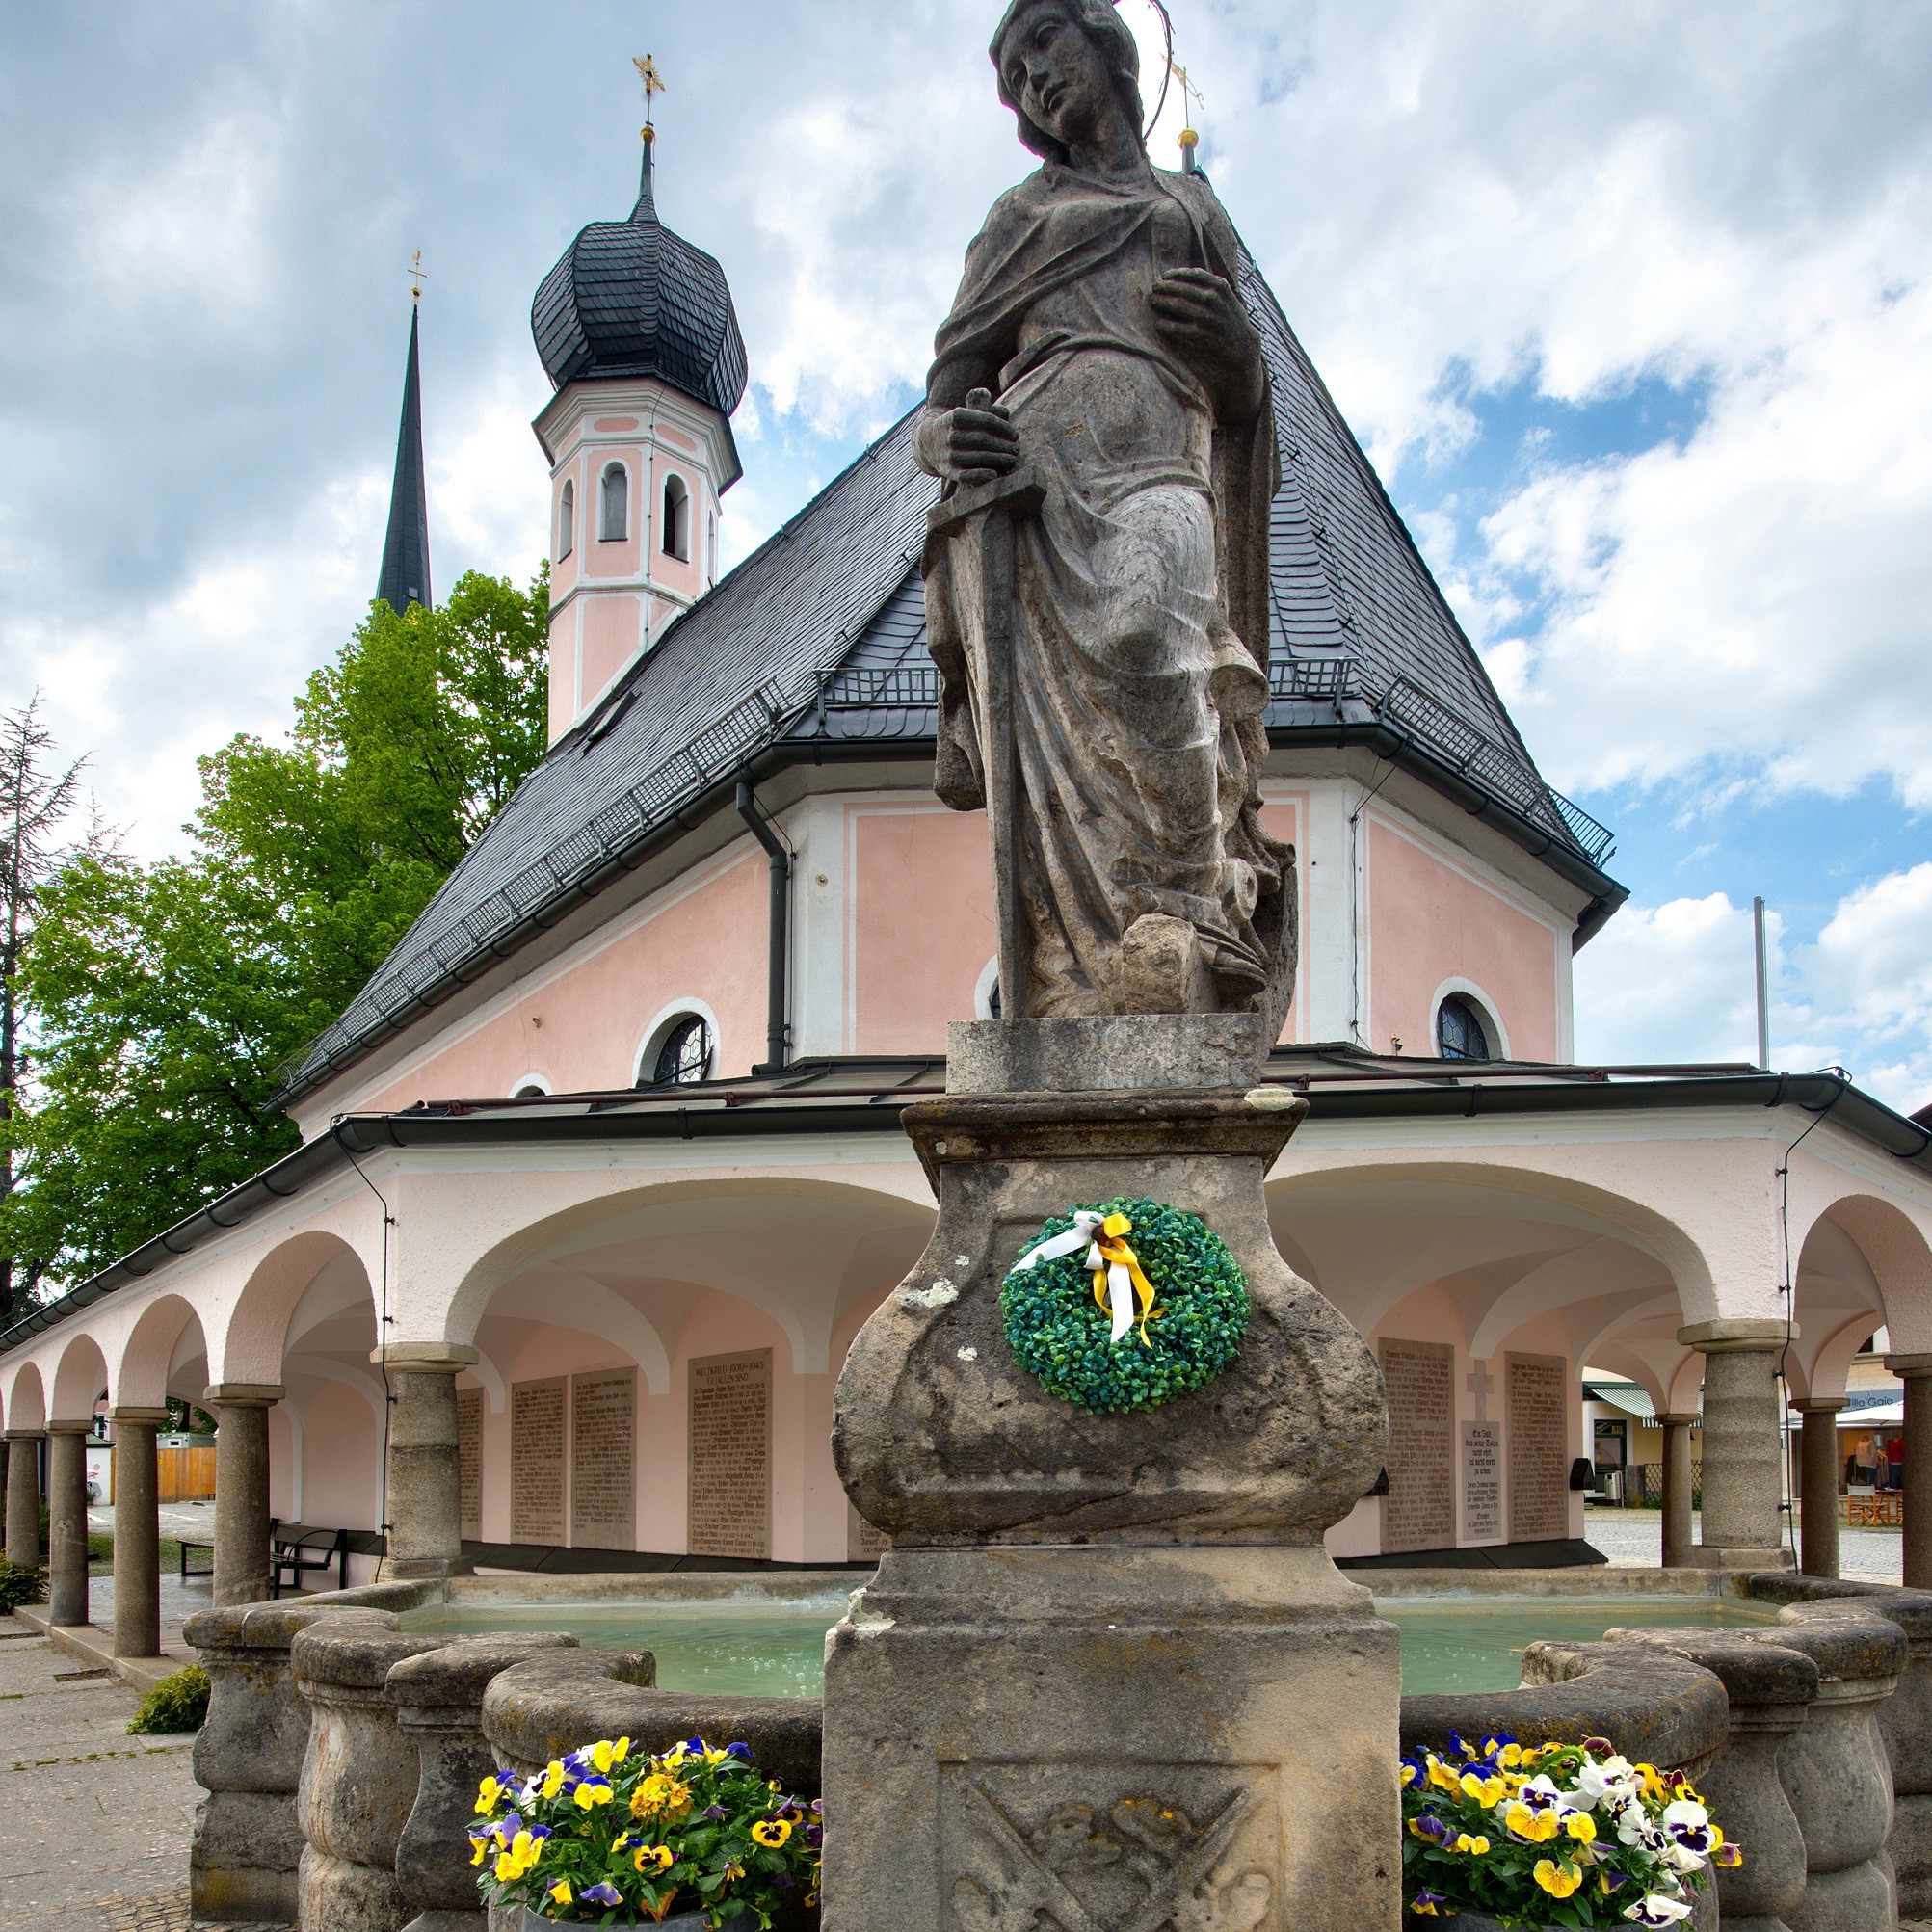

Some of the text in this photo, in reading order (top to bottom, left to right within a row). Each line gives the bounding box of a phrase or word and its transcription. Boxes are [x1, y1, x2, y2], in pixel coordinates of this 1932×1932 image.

[695, 1365, 728, 1376] WELTKRIEG
[1850, 1396, 1893, 1407] illa Gaia
